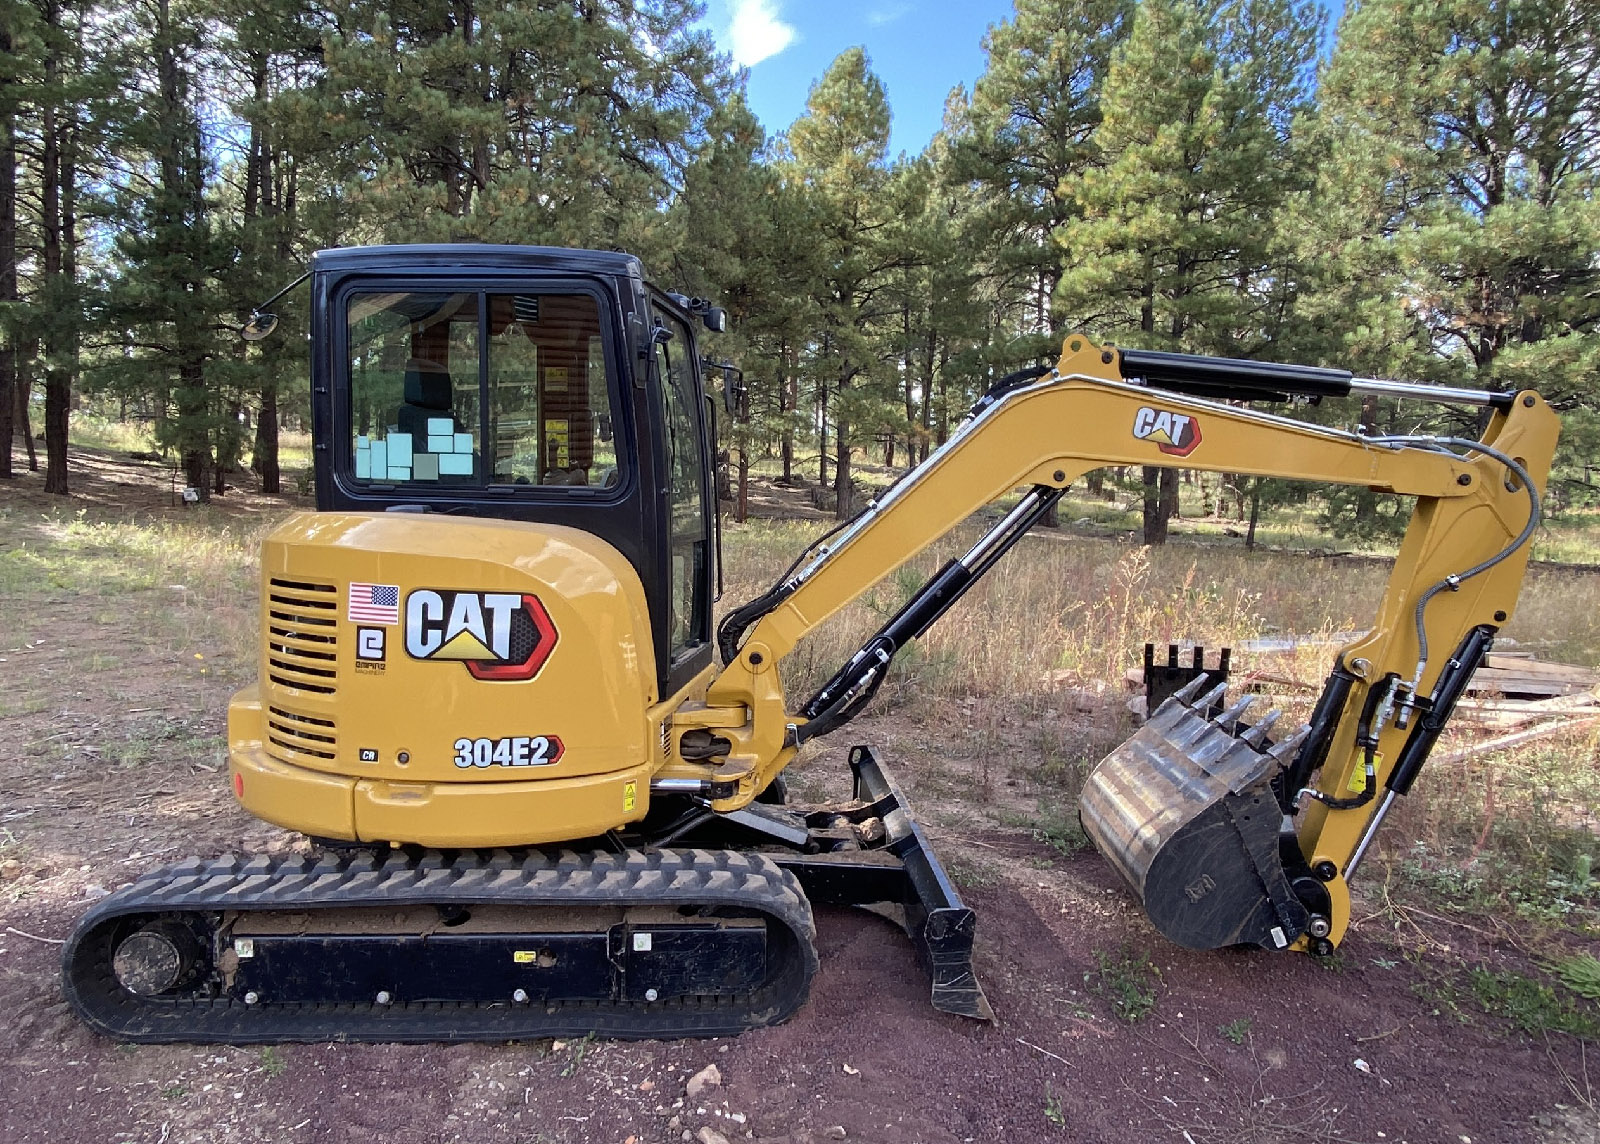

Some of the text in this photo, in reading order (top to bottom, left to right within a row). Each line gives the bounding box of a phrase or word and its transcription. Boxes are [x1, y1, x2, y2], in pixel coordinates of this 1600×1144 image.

[1133, 407, 1190, 446] CAT
[406, 589, 521, 660] CAT
[454, 736, 549, 768] 304E2
